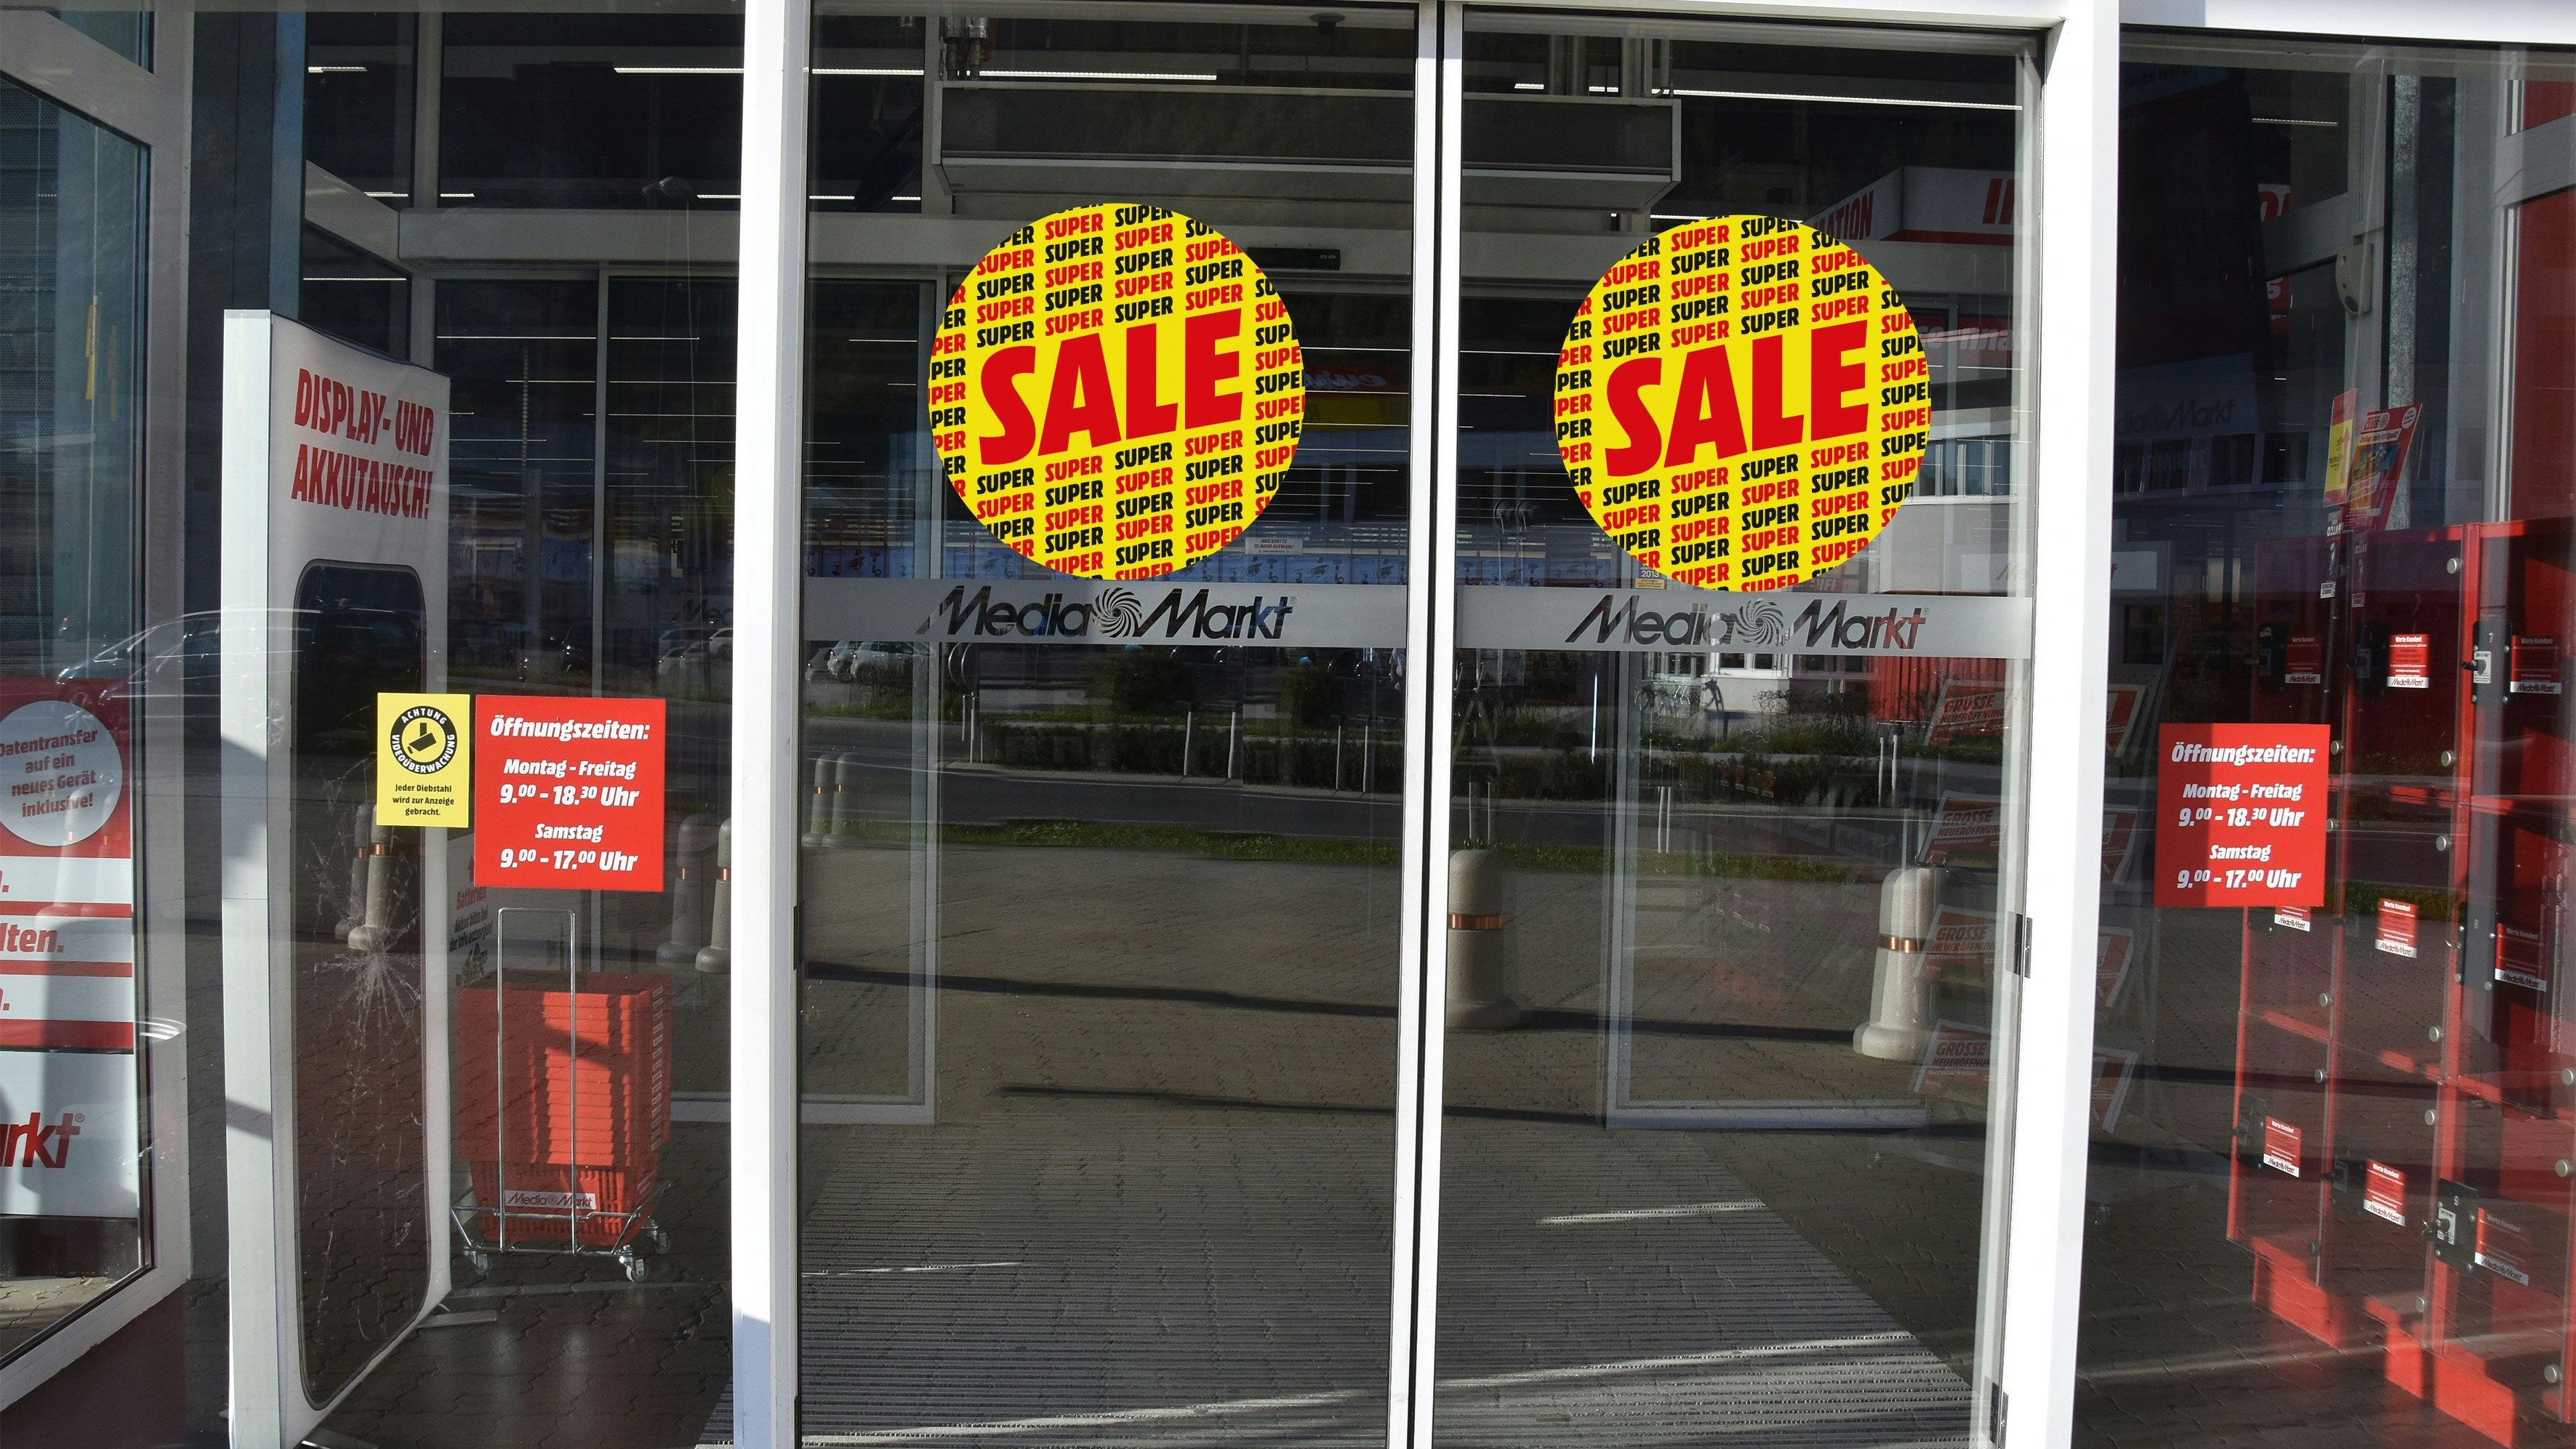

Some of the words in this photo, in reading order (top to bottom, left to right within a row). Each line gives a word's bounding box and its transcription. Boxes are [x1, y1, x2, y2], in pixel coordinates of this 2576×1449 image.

[1045, 213, 1104, 241] SUPER
[1115, 223, 1173, 252] SUPER
[1671, 225, 1730, 252] SUPER
[976, 249, 1035, 276] SUPER
[1045, 236, 1104, 264] SUPER
[1115, 248, 1173, 276] SUPER
[1671, 248, 1730, 276] SUPER
[1741, 235, 1799, 263] SUPER
[1045, 261, 1104, 289] SUPER
[1115, 271, 1173, 299] SUPER
[1185, 259, 1243, 286] SUPER
[1602, 260, 1661, 288] SUPER
[1671, 273, 1730, 300] SUPER
[1741, 260, 1799, 287] SUPER
[1811, 270, 1869, 298] SUPER
[976, 273, 1035, 301] SUPER
[1045, 284, 1103, 312] SUPER
[1185, 284, 1243, 311] SUPER
[1602, 284, 1661, 313] SUPER
[1741, 283, 1799, 310] SUPER
[976, 296, 1035, 324] SUPER
[1045, 308, 1104, 337] SUPER
[1115, 296, 1173, 324] SUPER
[1602, 308, 1661, 336] SUPER
[1671, 295, 1729, 324] SUPER
[1741, 308, 1799, 335] SUPER
[1811, 295, 1869, 323] SUPER
[976, 321, 1035, 348] SUPER
[1602, 332, 1661, 360] SUPER
[1671, 320, 1730, 348] SUPER
[979, 308, 1243, 465] SALE
[1605, 320, 1869, 477] SALE
[294, 367, 391, 445] DISPLAY-
[395, 399, 434, 457] UND
[1115, 442, 1173, 470] SUPER
[1184, 430, 1243, 457] SUPER
[1810, 441, 1869, 469] SUPER
[292, 443, 433, 519] AKKUTAUSCH!
[976, 467, 1035, 495] SUPER
[1045, 455, 1103, 483] SUPER
[1115, 467, 1173, 495] SUPER
[1185, 454, 1243, 482] SUPER
[1671, 467, 1729, 494] SUPER
[1741, 454, 1799, 482] SUPER
[1811, 466, 1869, 494] SUPER
[976, 492, 1035, 520] SUPER
[1045, 480, 1104, 507] SUPER
[1115, 491, 1173, 520] SUPER
[1185, 479, 1243, 507] SUPER
[1602, 479, 1661, 507] SUPER
[1671, 491, 1730, 519] SUPER
[1741, 478, 1799, 507] SUPER
[1811, 491, 1869, 518] SUPER
[1045, 505, 1104, 532] SUPER
[1115, 514, 1173, 542] SUPER
[1185, 502, 1243, 529] SUPER
[1602, 504, 1661, 531] SUPER
[1741, 503, 1799, 531] SUPER
[1811, 513, 1869, 541] SUPER
[1045, 526, 1104, 554] SUPER
[1671, 516, 1730, 544] SUPER
[1741, 526, 1799, 553] SUPER
[1115, 539, 1173, 566] SUPER
[1671, 538, 1730, 566] SUPER
[1741, 550, 1799, 578] SUPER
[915, 585, 1092, 635] Media
[1130, 588, 1293, 639] Markt
[1565, 595, 1738, 645] Media
[1783, 599, 1926, 649] Markt
[2489, 633, 2494, 643] 7
[401, 708, 447, 726] ACHTUNG
[1943, 694, 1995, 713] GROSSE
[490, 715, 650, 742] Öffnungszeiten:
[0, 729, 98, 757] Datentransfer
[391, 734, 456, 774] VIDEOÜBERWACHUNG
[2171, 742, 2316, 766] Öffnungszeiten:
[25, 756, 50, 774] auf
[52, 753, 75, 769] ein
[503, 759, 566, 778] Montag
[579, 760, 636, 780] Freitag
[12, 779, 55, 797] neues
[57, 770, 96, 789] Gerät
[417, 784, 452, 792] Diebstahl
[499, 784, 537, 804] 9.00
[553, 785, 598, 806] 18.30
[600, 787, 640, 807] Uhr
[2183, 784, 2241, 801] Montag
[2250, 783, 2303, 801] Freitag
[23, 792, 93, 817] inklusive!
[405, 807, 441, 816] gebracht.
[425, 796, 454, 806] Anzeige
[1937, 824, 2002, 837] NEUERÖFFNUN
[1941, 809, 1994, 827] GROSSE
[2178, 808, 2212, 827] 9.00
[2226, 808, 2267, 827] 18.30
[2269, 808, 2305, 827] Uhr
[535, 824, 603, 843] Samstag
[499, 848, 537, 868] 9.00
[553, 850, 596, 870] 17.00
[599, 851, 638, 871] Uhr
[2209, 844, 2272, 862] Samstag
[2177, 870, 2211, 888] 9.00
[2225, 870, 2264, 888] 17.00
[2266, 869, 2302, 888] Uhr
[1935, 926, 1989, 941] GROSSE
[1935, 1041, 1987, 1056] GROSSE
[0, 1112, 80, 1168] rkt
[507, 1192, 547, 1205] Media
